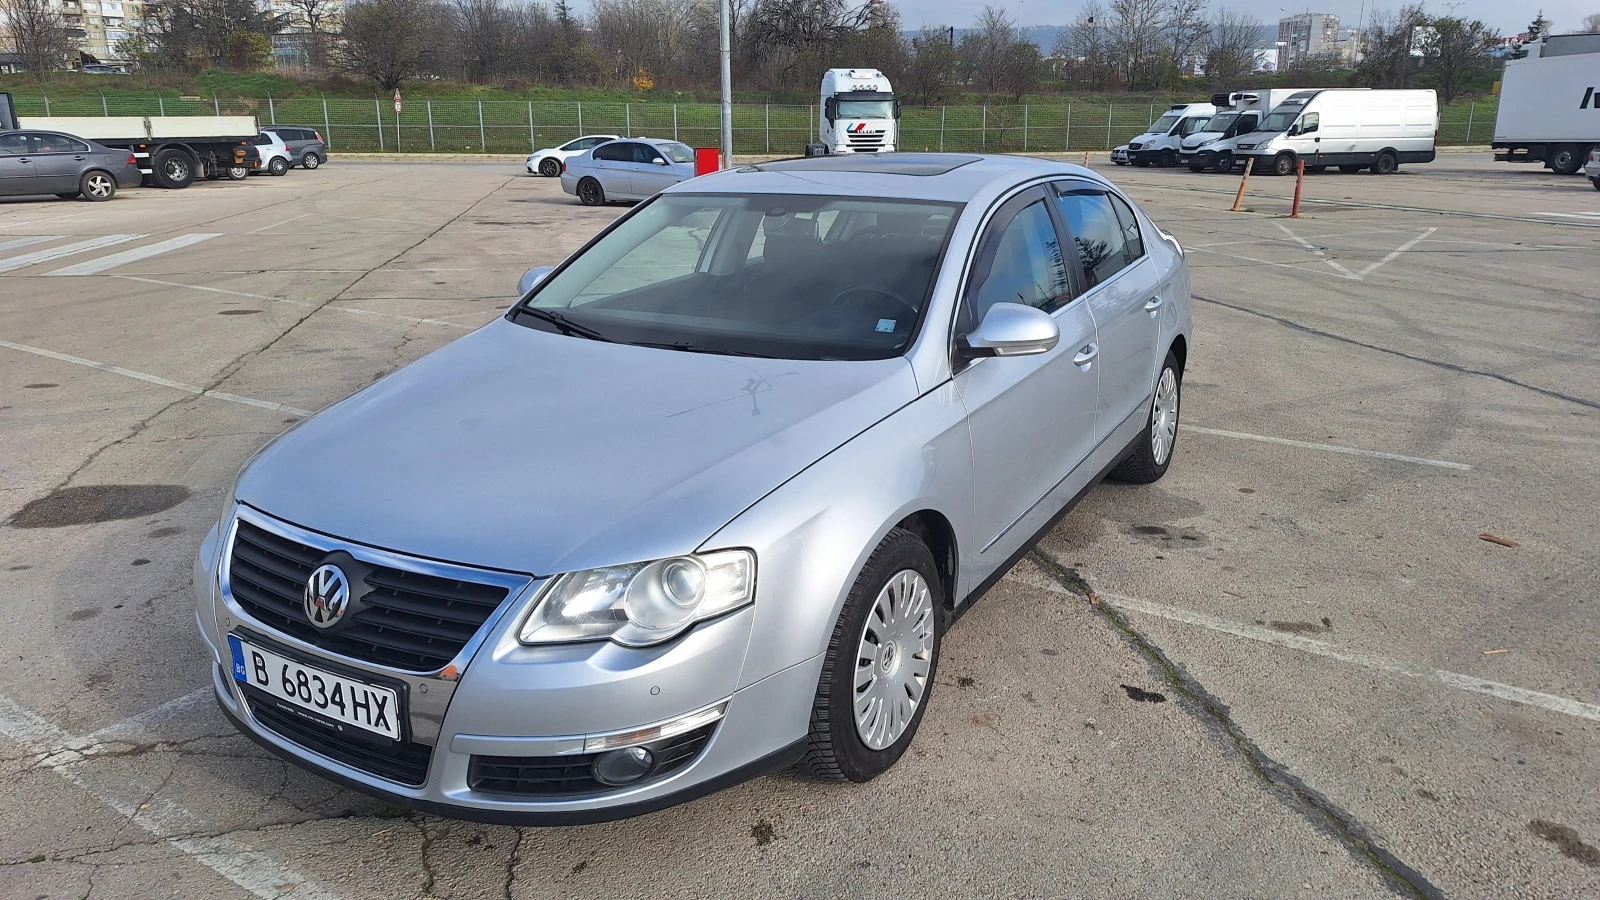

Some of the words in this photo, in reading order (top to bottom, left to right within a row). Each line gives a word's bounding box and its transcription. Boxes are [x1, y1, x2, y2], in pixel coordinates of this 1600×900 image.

[305, 565, 349, 627] VW
[235, 662, 245, 676] BG
[251, 650, 269, 686] B
[281, 664, 346, 717] 6834
[350, 686, 392, 732] HX
